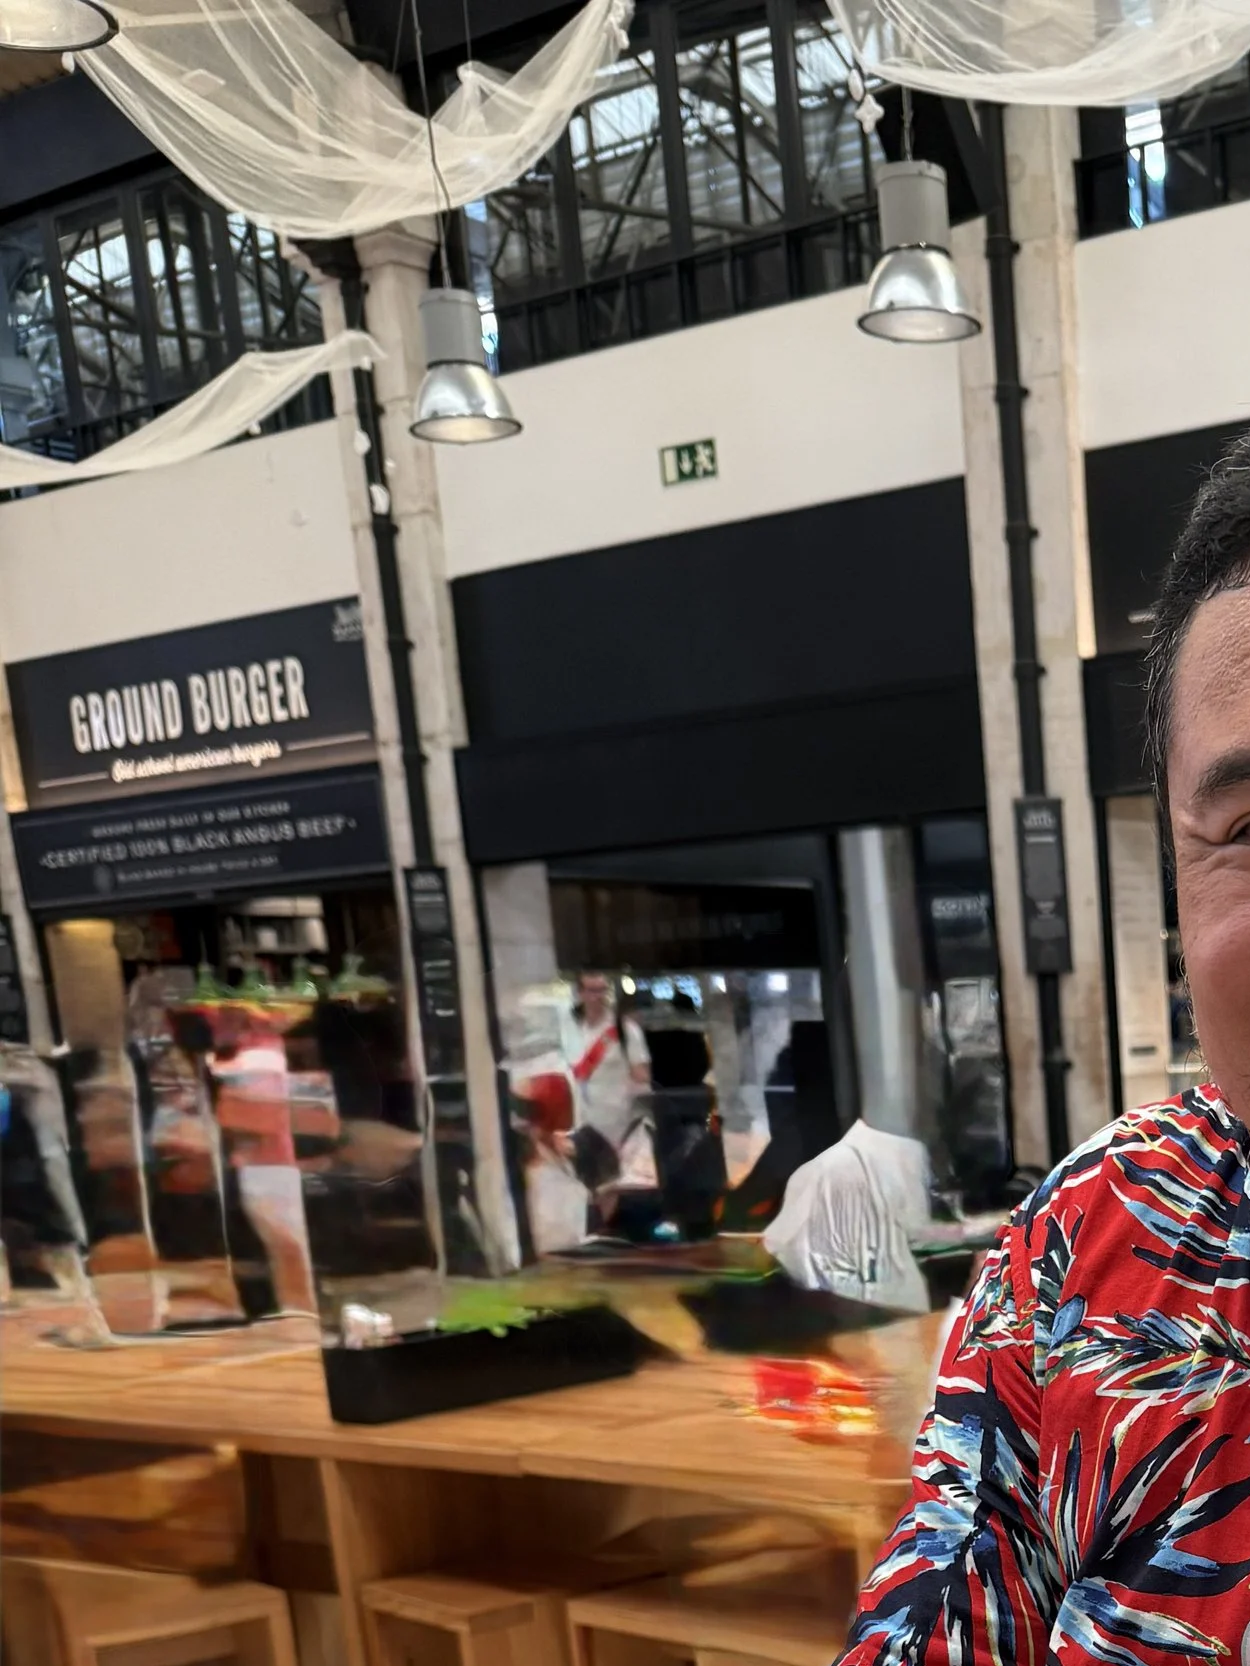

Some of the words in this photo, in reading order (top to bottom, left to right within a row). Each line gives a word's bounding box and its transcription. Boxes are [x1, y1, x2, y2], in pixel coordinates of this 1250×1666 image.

[69, 678, 184, 753] GROUND
[187, 656, 310, 735] BURGER
[172, 829, 230, 854] BLACK
